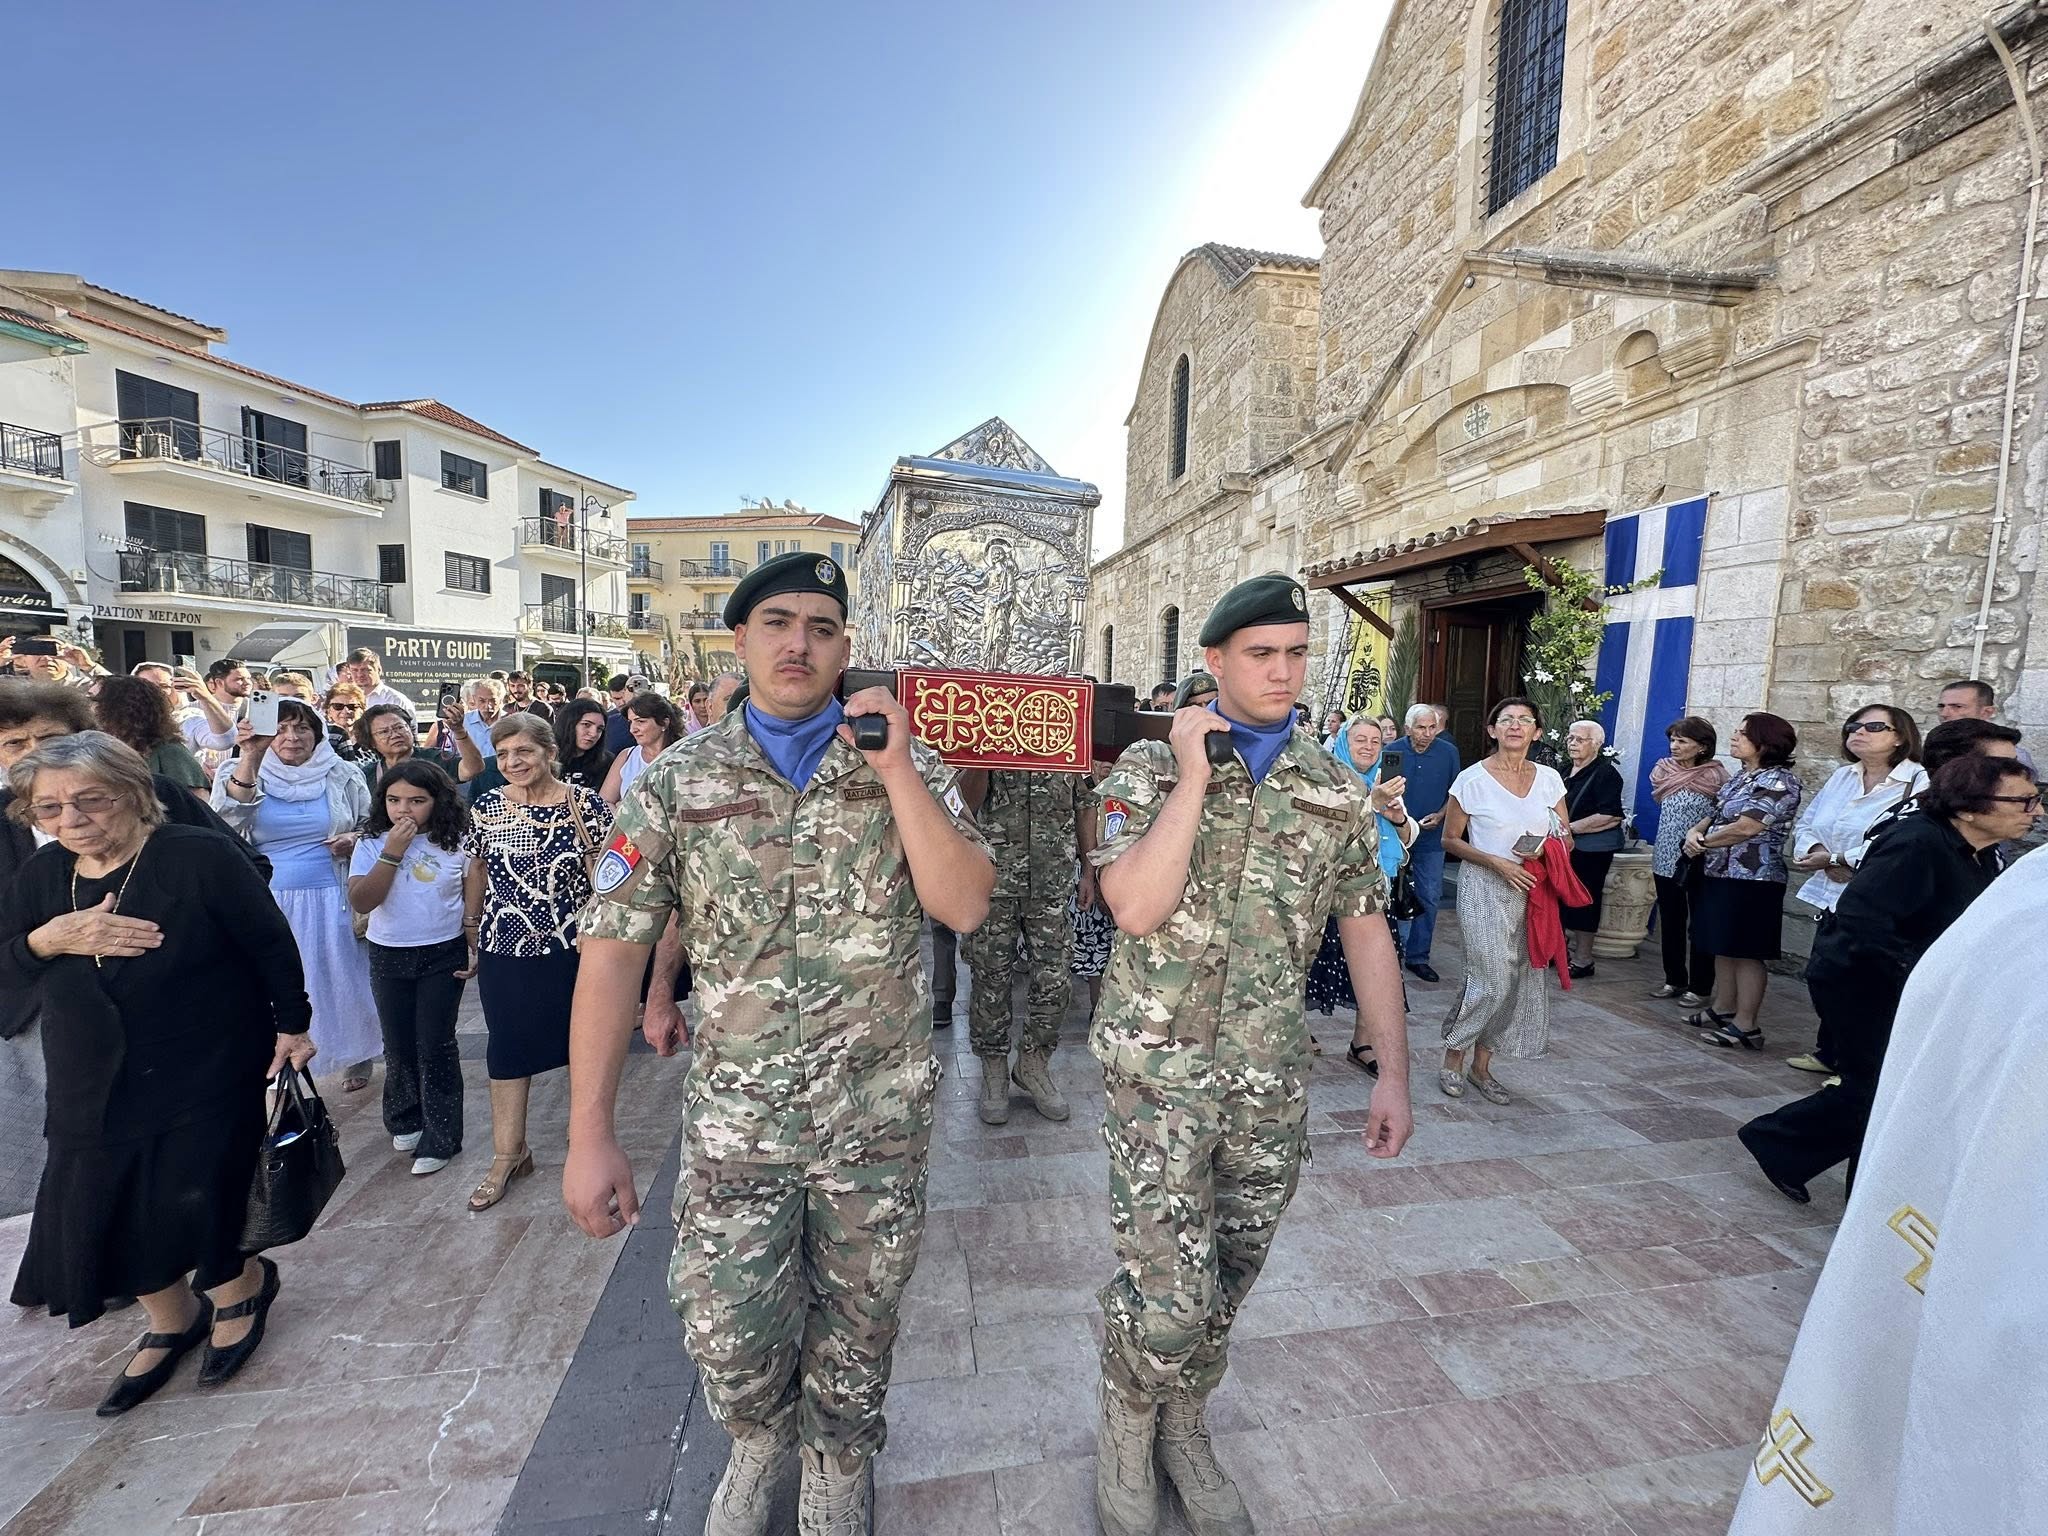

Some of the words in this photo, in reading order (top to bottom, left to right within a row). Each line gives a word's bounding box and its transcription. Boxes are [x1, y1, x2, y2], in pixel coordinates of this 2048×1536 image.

[149, 610, 202, 624] ΜΕΓΑΡΟΝ
[385, 636, 442, 659] PARTY
[446, 640, 492, 660] GUIDE
[422, 660, 458, 668] EQUIPMENT
